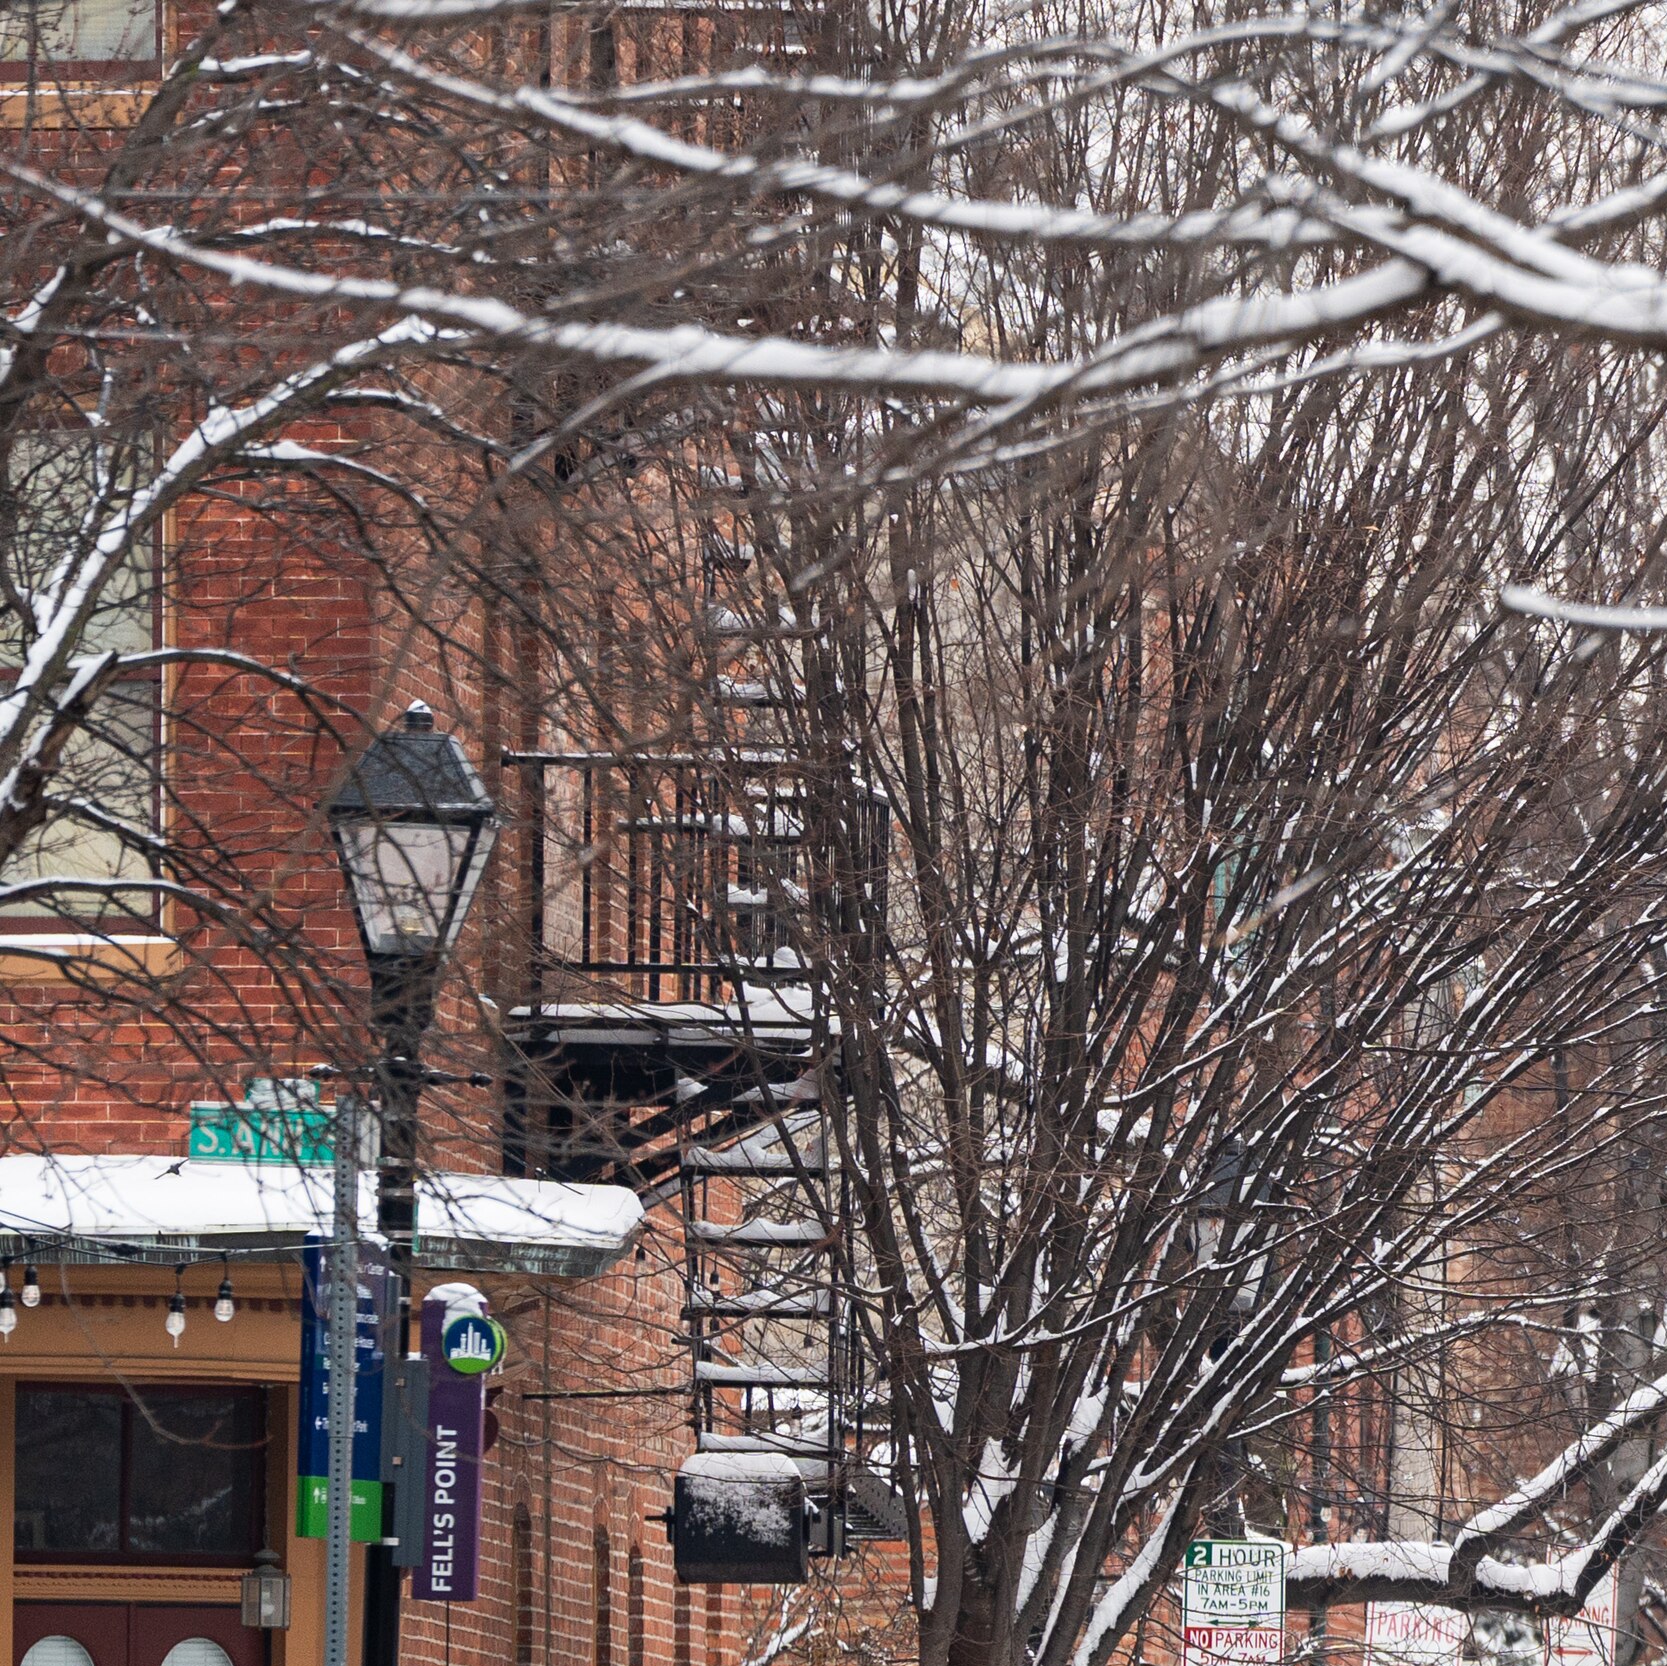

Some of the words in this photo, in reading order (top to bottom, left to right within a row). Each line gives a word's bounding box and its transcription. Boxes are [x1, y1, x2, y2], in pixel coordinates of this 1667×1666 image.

[434, 1424, 458, 1505] POINT
[431, 1513, 455, 1592] FELL'S
[1193, 1546, 1207, 1566] 2
[1219, 1549, 1276, 1567] HOUR
[1195, 1569, 1242, 1582] PARKING
[1246, 1571, 1273, 1583] LIMIT
[1197, 1584, 1209, 1595] IN
[1213, 1584, 1246, 1596] AREA
[1251, 1585, 1270, 1597] #16
[1200, 1598, 1268, 1611] 7AM-5PM
[1377, 1612, 1455, 1645] PARKING
[1189, 1630, 1209, 1648] NO
[1215, 1632, 1278, 1649] PARKING
[1200, 1652, 1266, 1666] 5PM7AM
